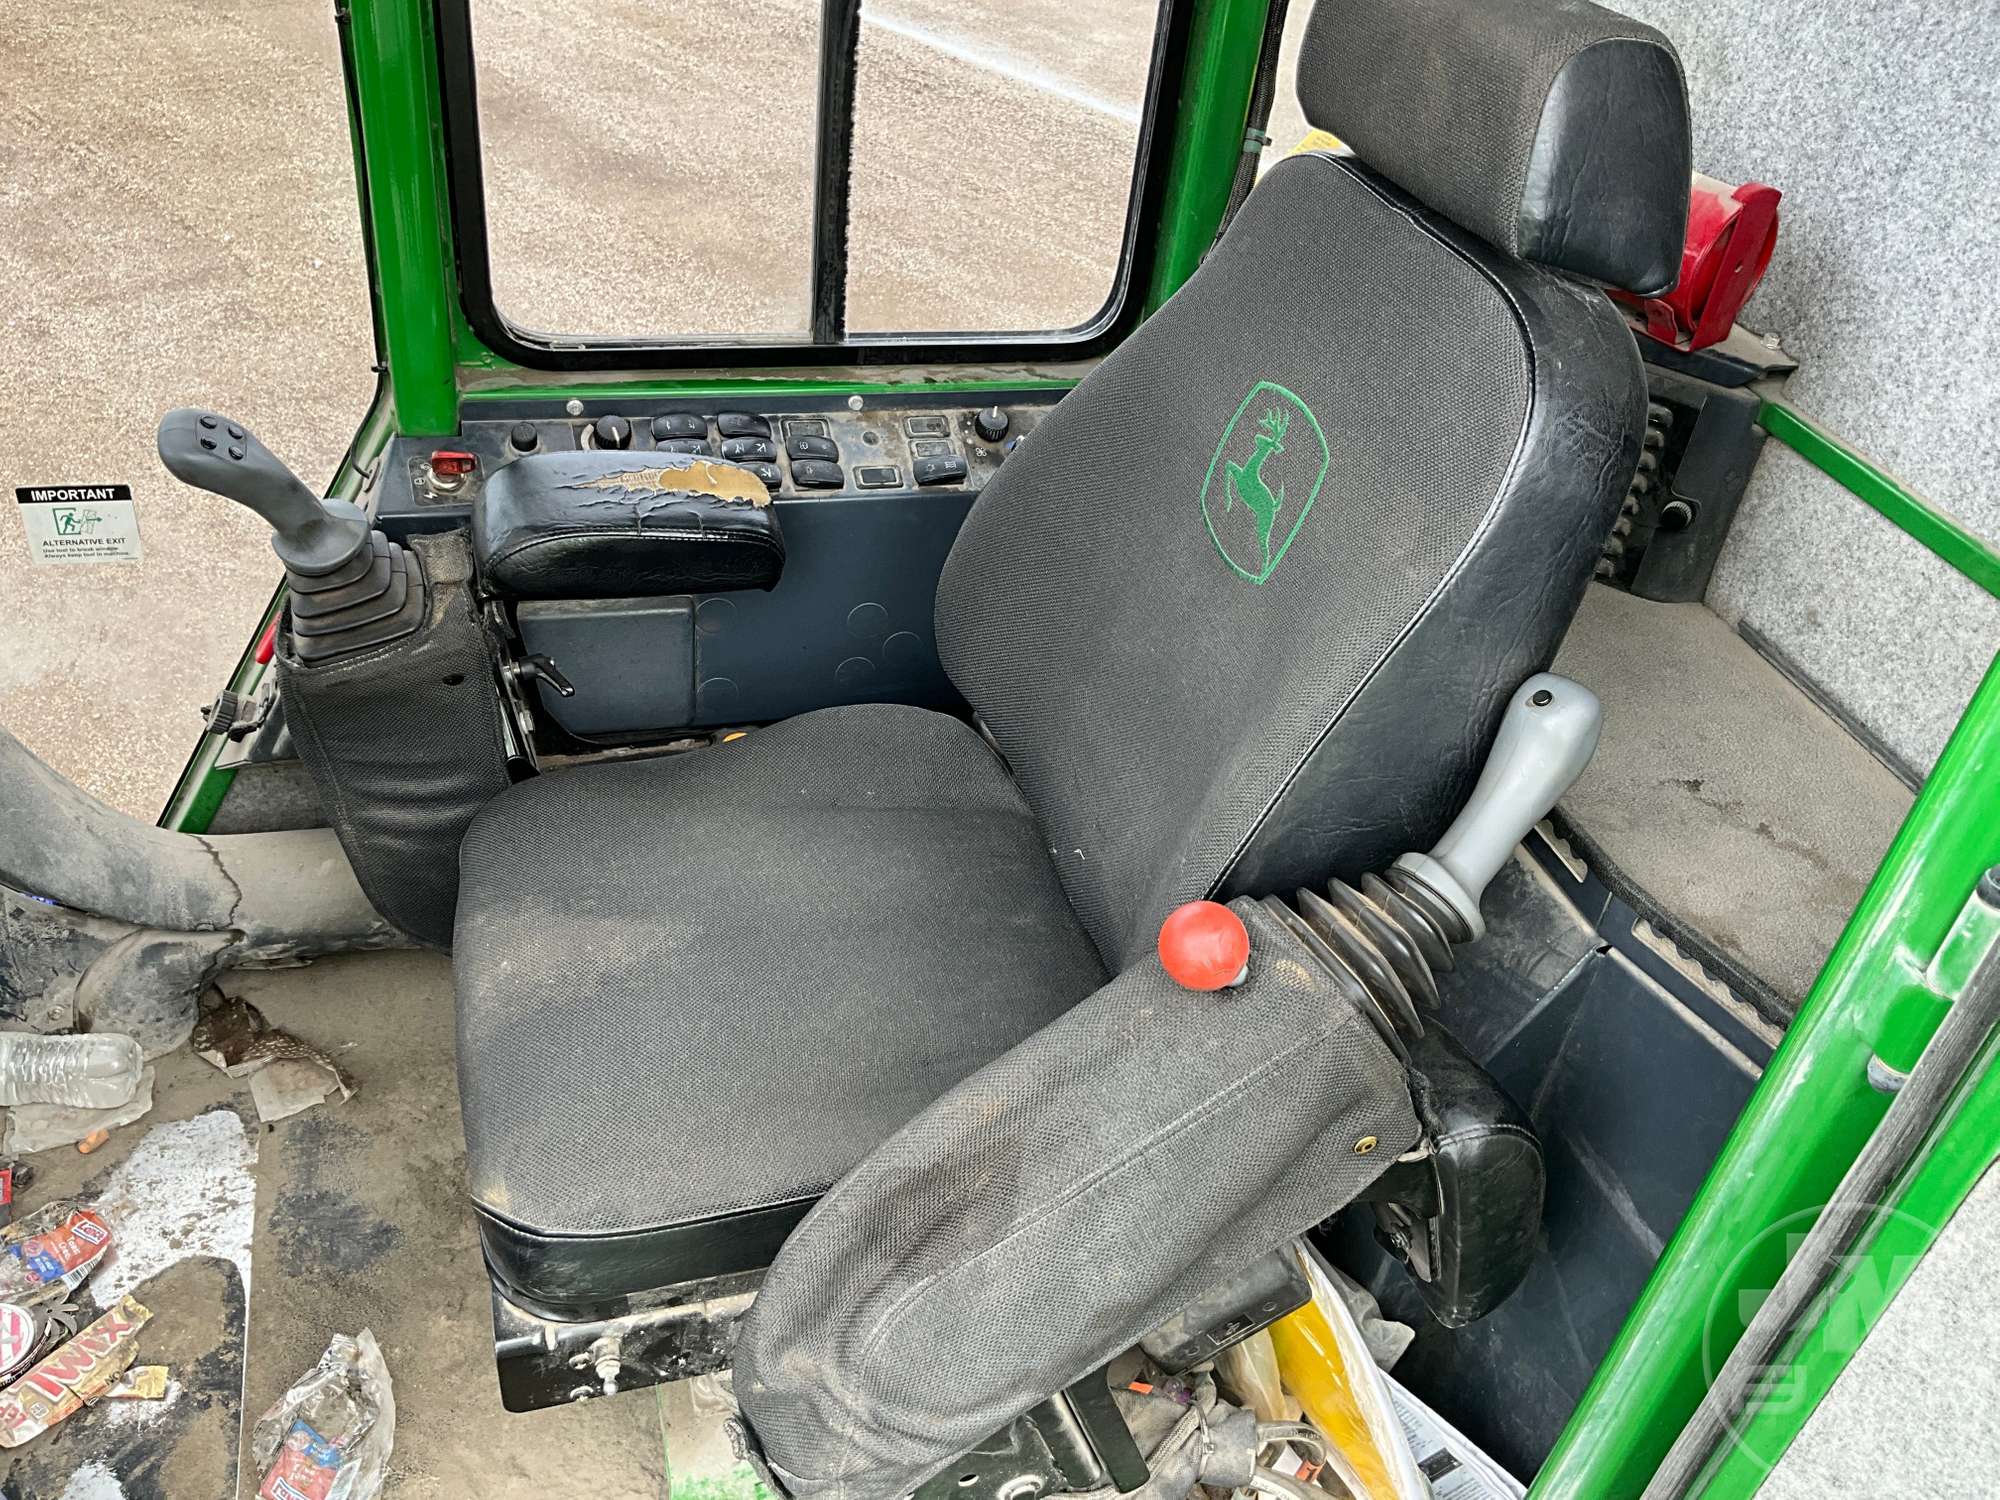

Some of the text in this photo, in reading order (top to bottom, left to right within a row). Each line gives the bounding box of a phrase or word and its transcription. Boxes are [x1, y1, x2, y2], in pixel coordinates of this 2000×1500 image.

[31, 488, 115, 501] IMPORTANT
[43, 537, 126, 546] ALTERNATIVE EXIT
